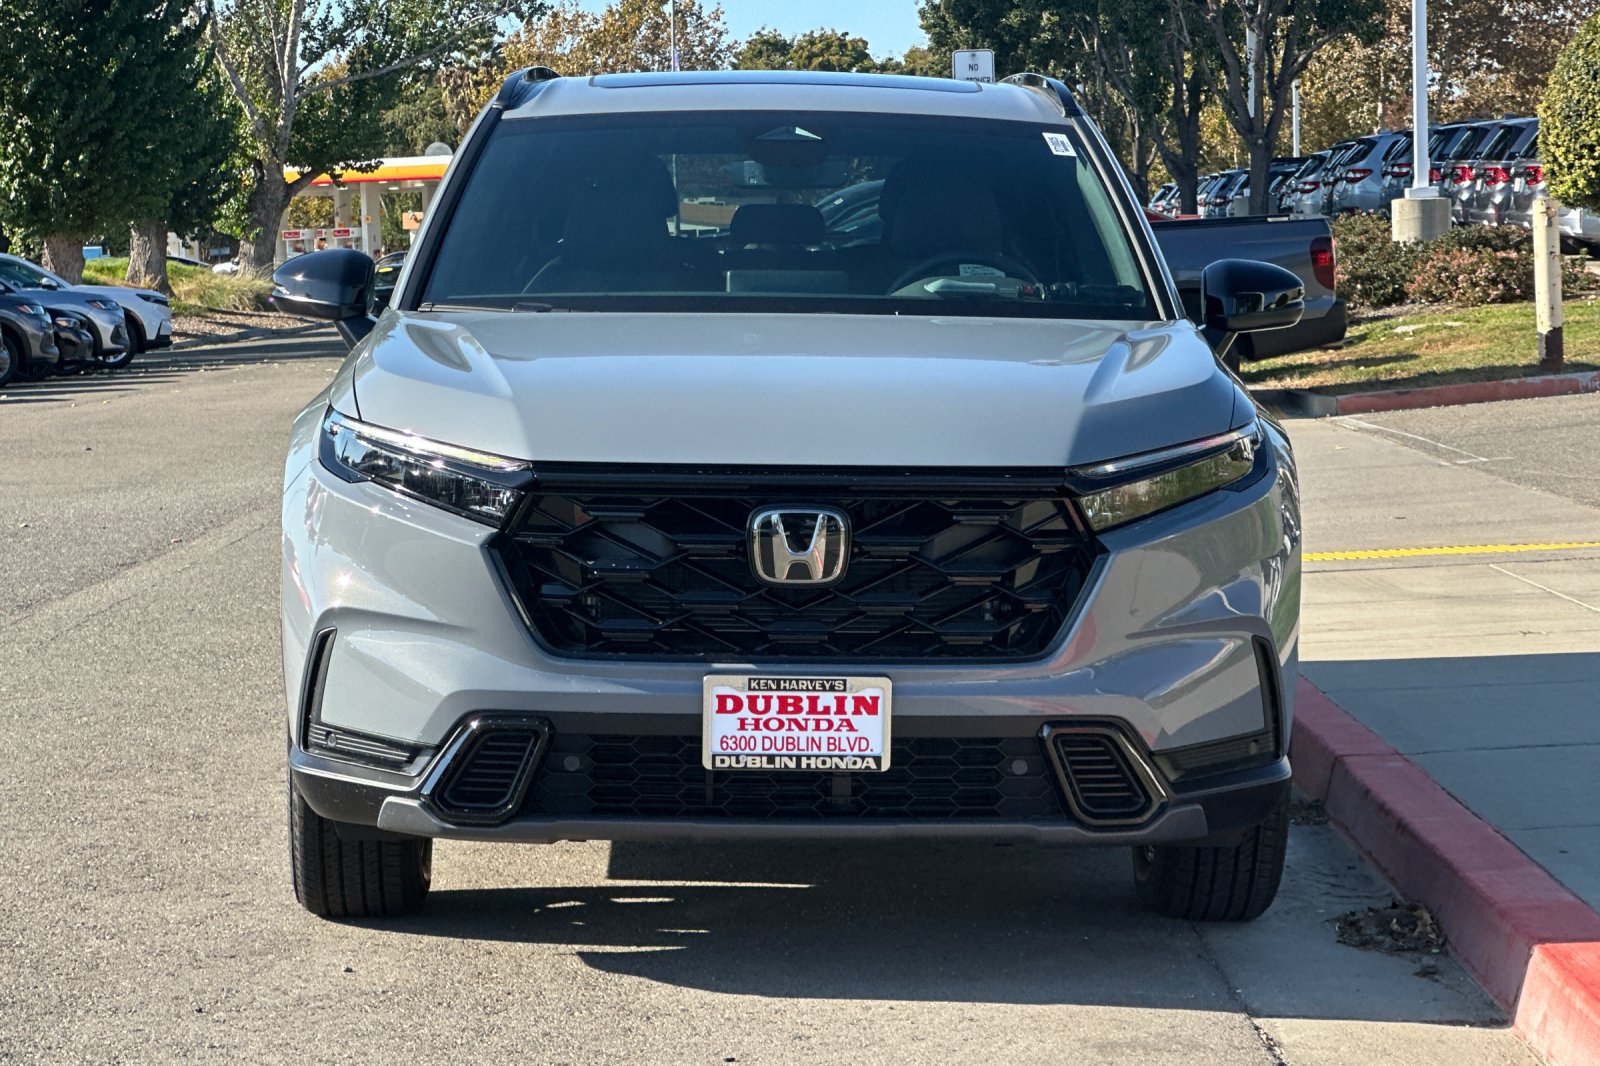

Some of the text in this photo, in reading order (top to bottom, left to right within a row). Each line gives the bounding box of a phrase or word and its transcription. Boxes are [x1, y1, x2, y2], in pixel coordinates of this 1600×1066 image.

[750, 679, 845, 691] KEN HARVEY'S
[715, 695, 880, 716] DUBLIN
[737, 717, 858, 732] HONDA
[720, 735, 874, 752] 6300 DUBLIN BLVD.
[715, 755, 877, 769] DUBLIN HONDA
